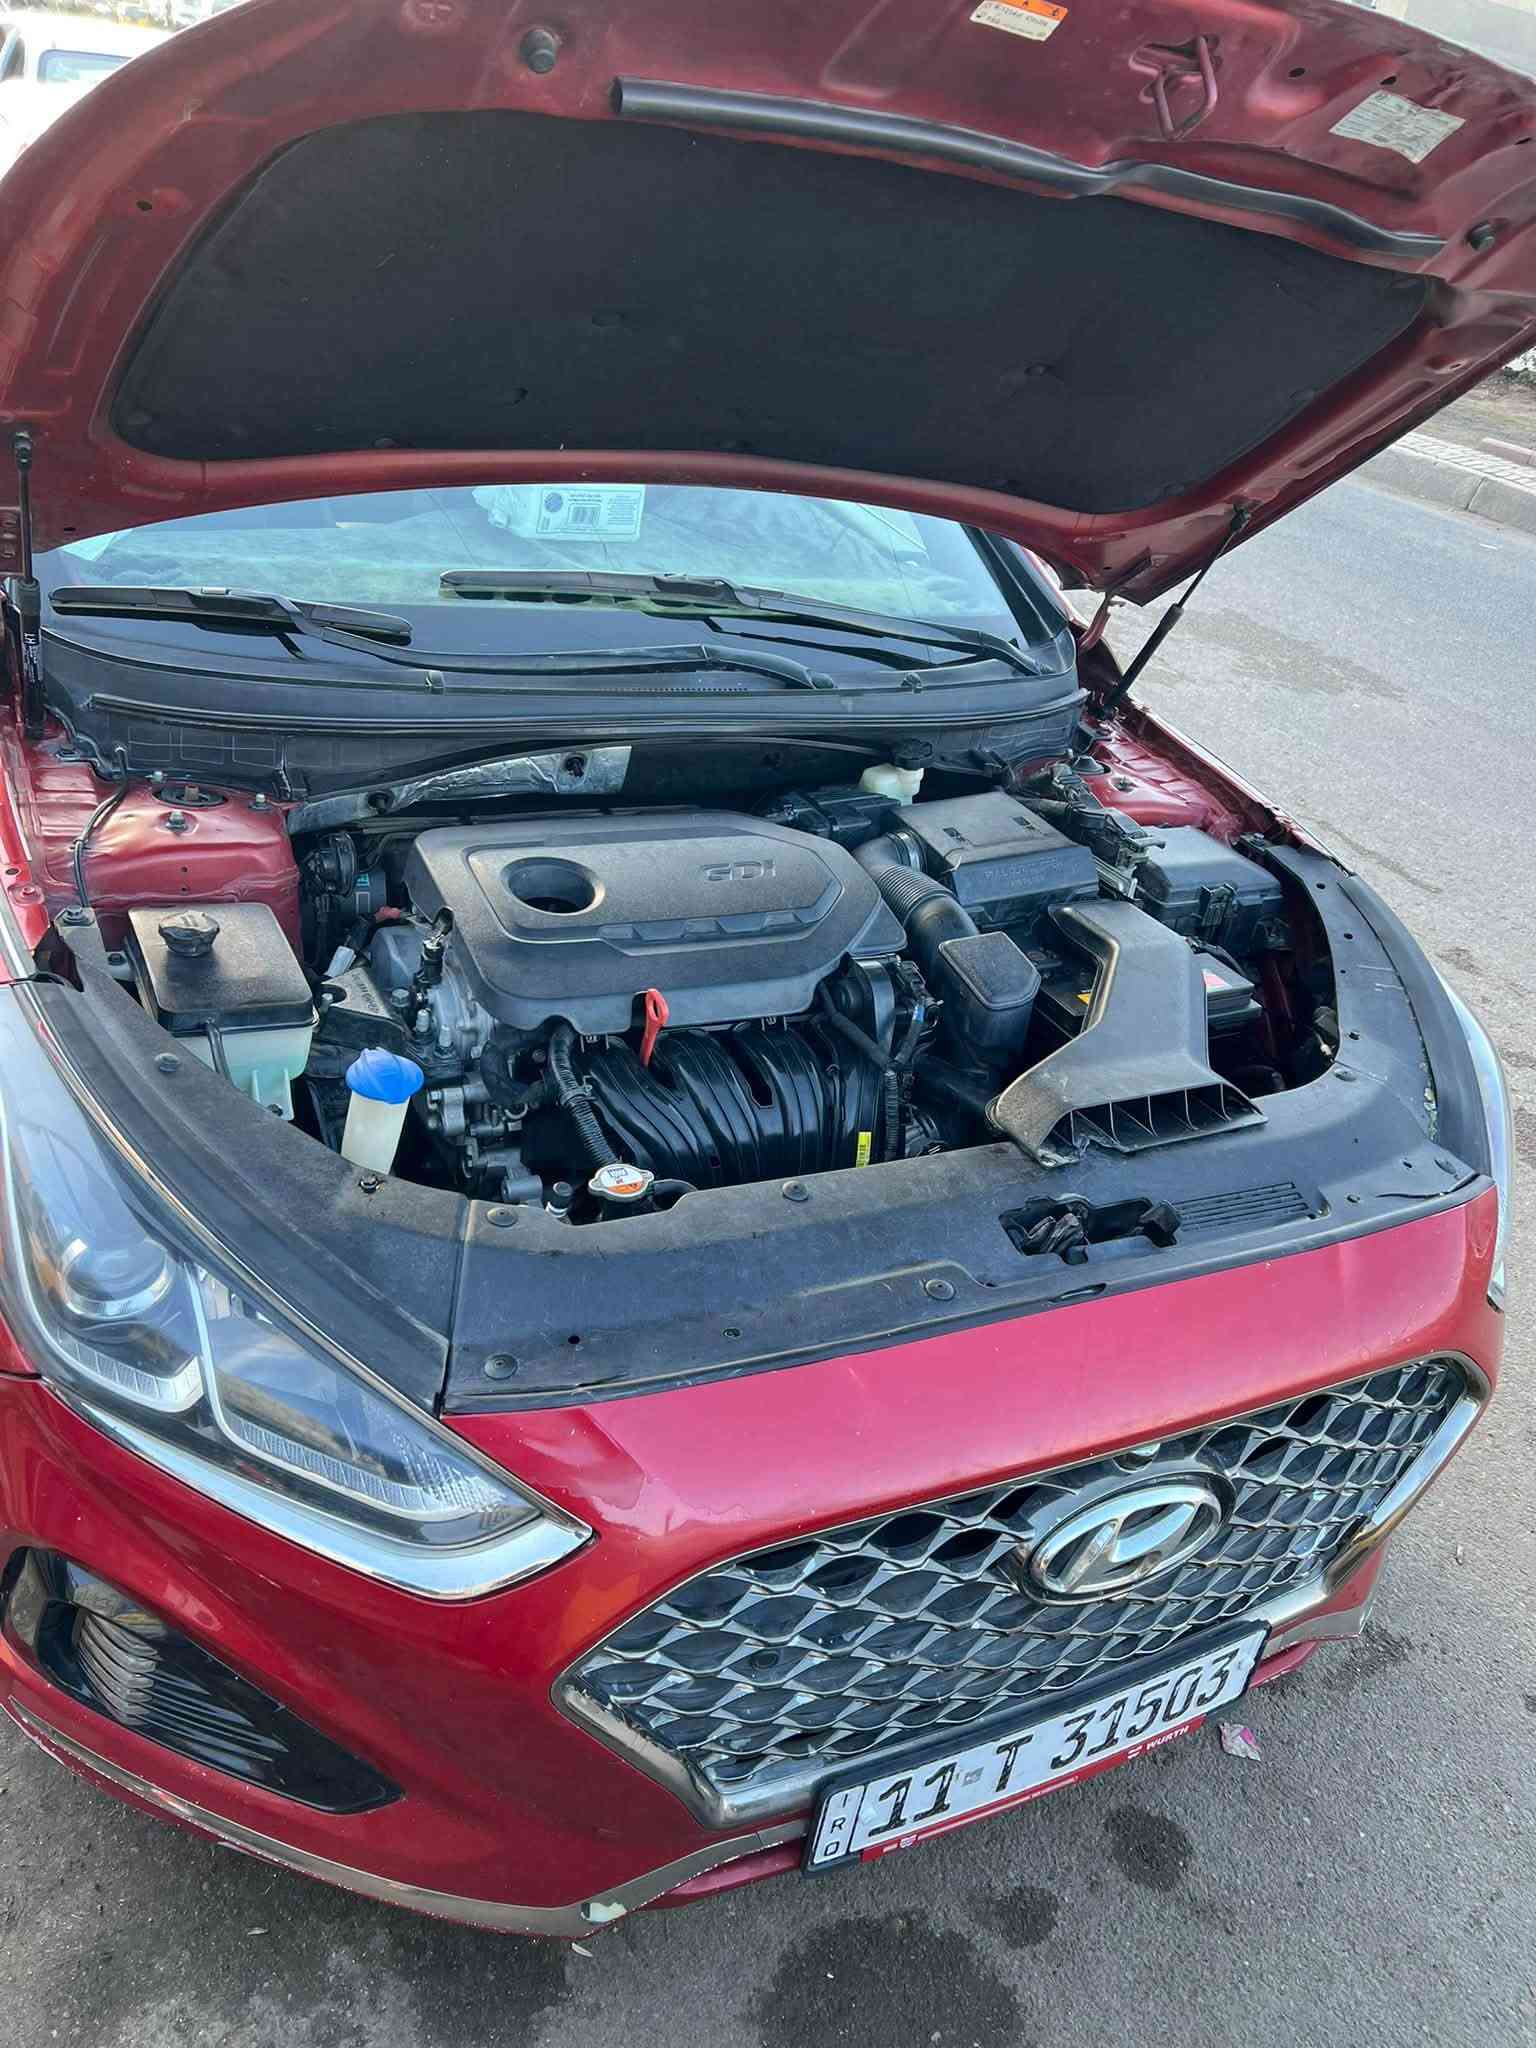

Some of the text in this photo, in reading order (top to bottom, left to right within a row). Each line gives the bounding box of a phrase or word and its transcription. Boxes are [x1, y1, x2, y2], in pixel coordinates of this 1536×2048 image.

[868, 1648, 1240, 1837] 11 T 31503
